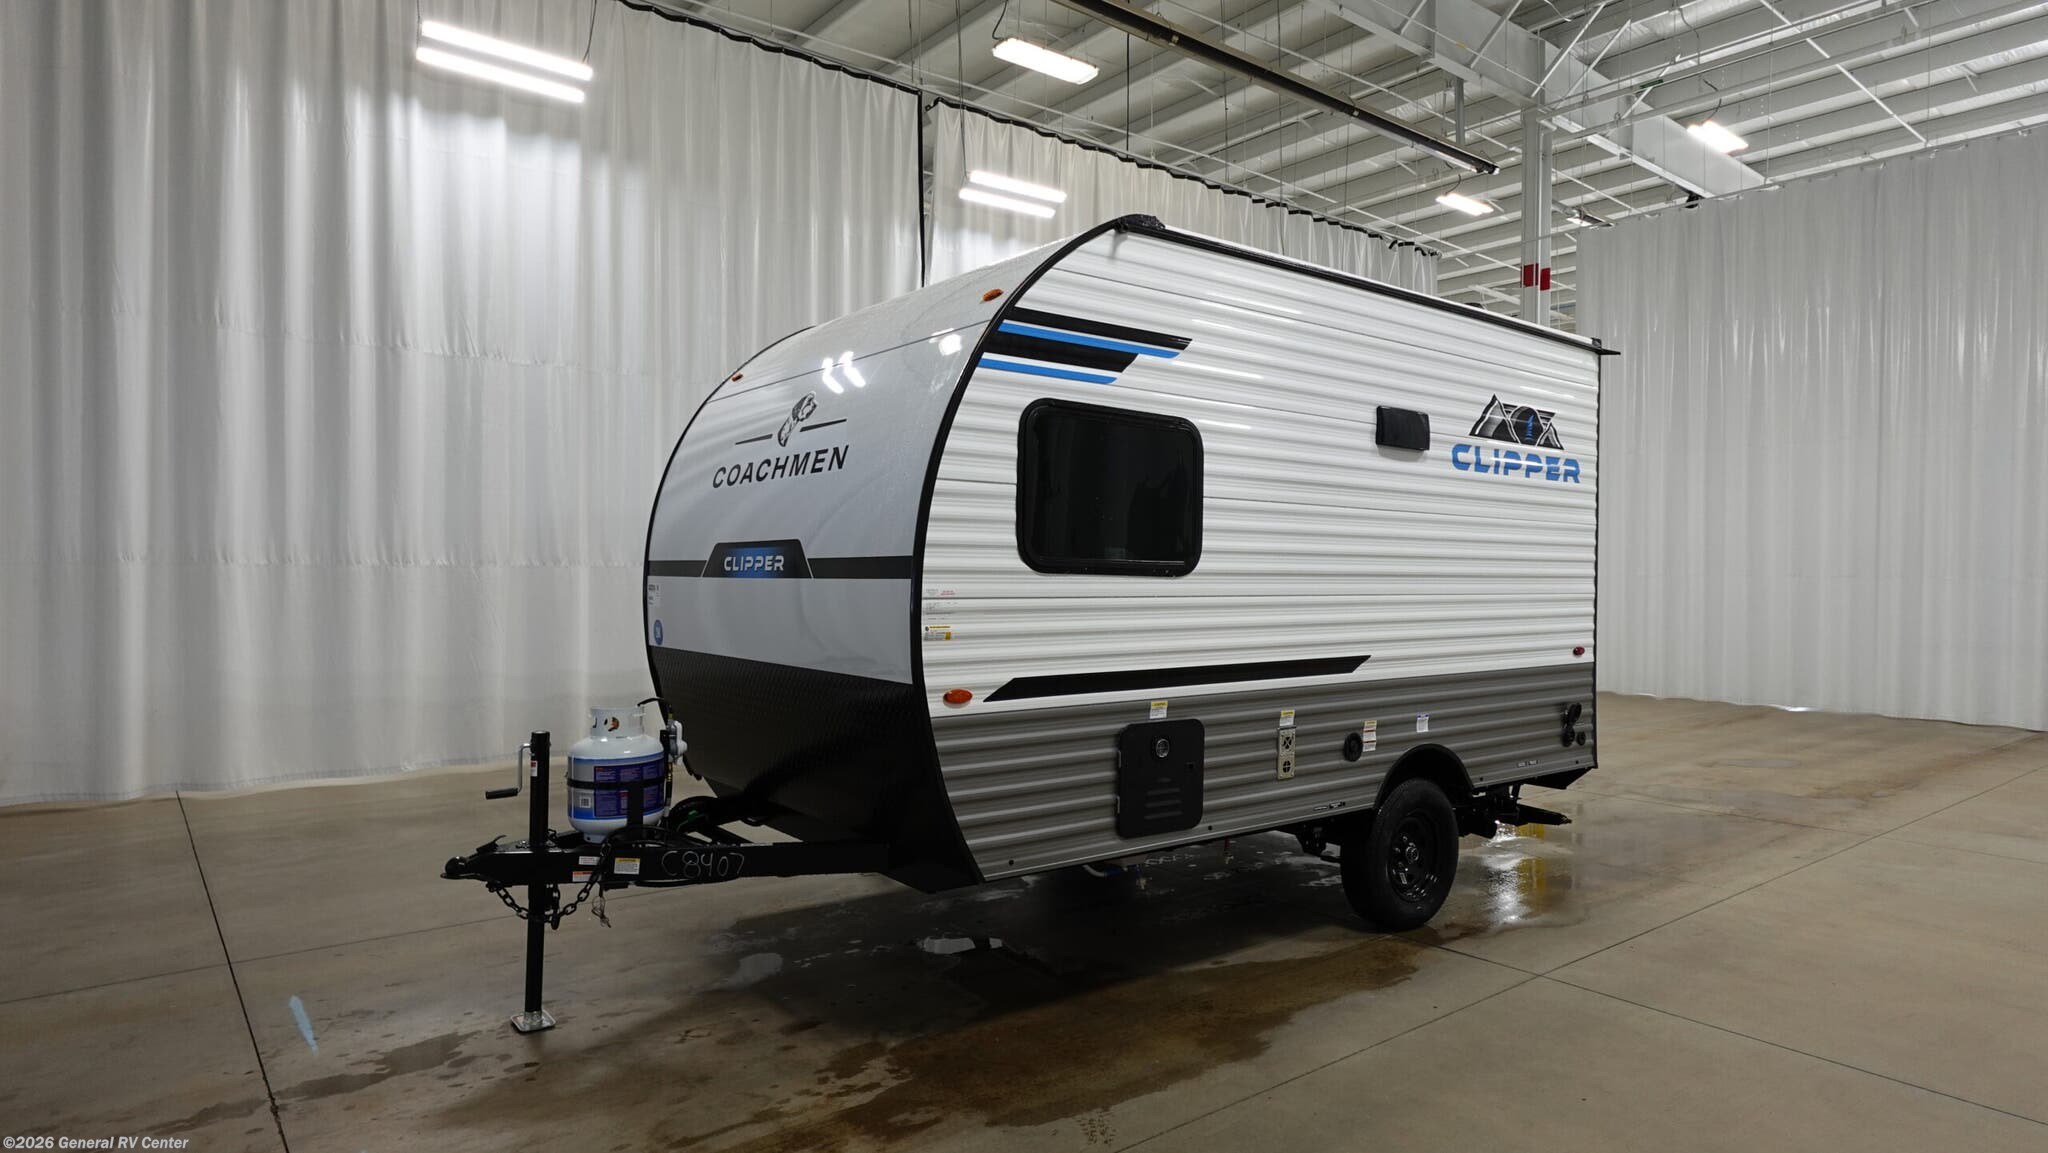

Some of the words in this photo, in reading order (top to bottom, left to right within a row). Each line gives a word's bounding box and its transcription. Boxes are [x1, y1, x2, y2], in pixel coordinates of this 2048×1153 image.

[712, 445, 849, 489] COACHMEN
[1451, 443, 1580, 484] CLIPPER
[723, 555, 785, 572] CLIPPER
[661, 850, 746, 879] C8407
